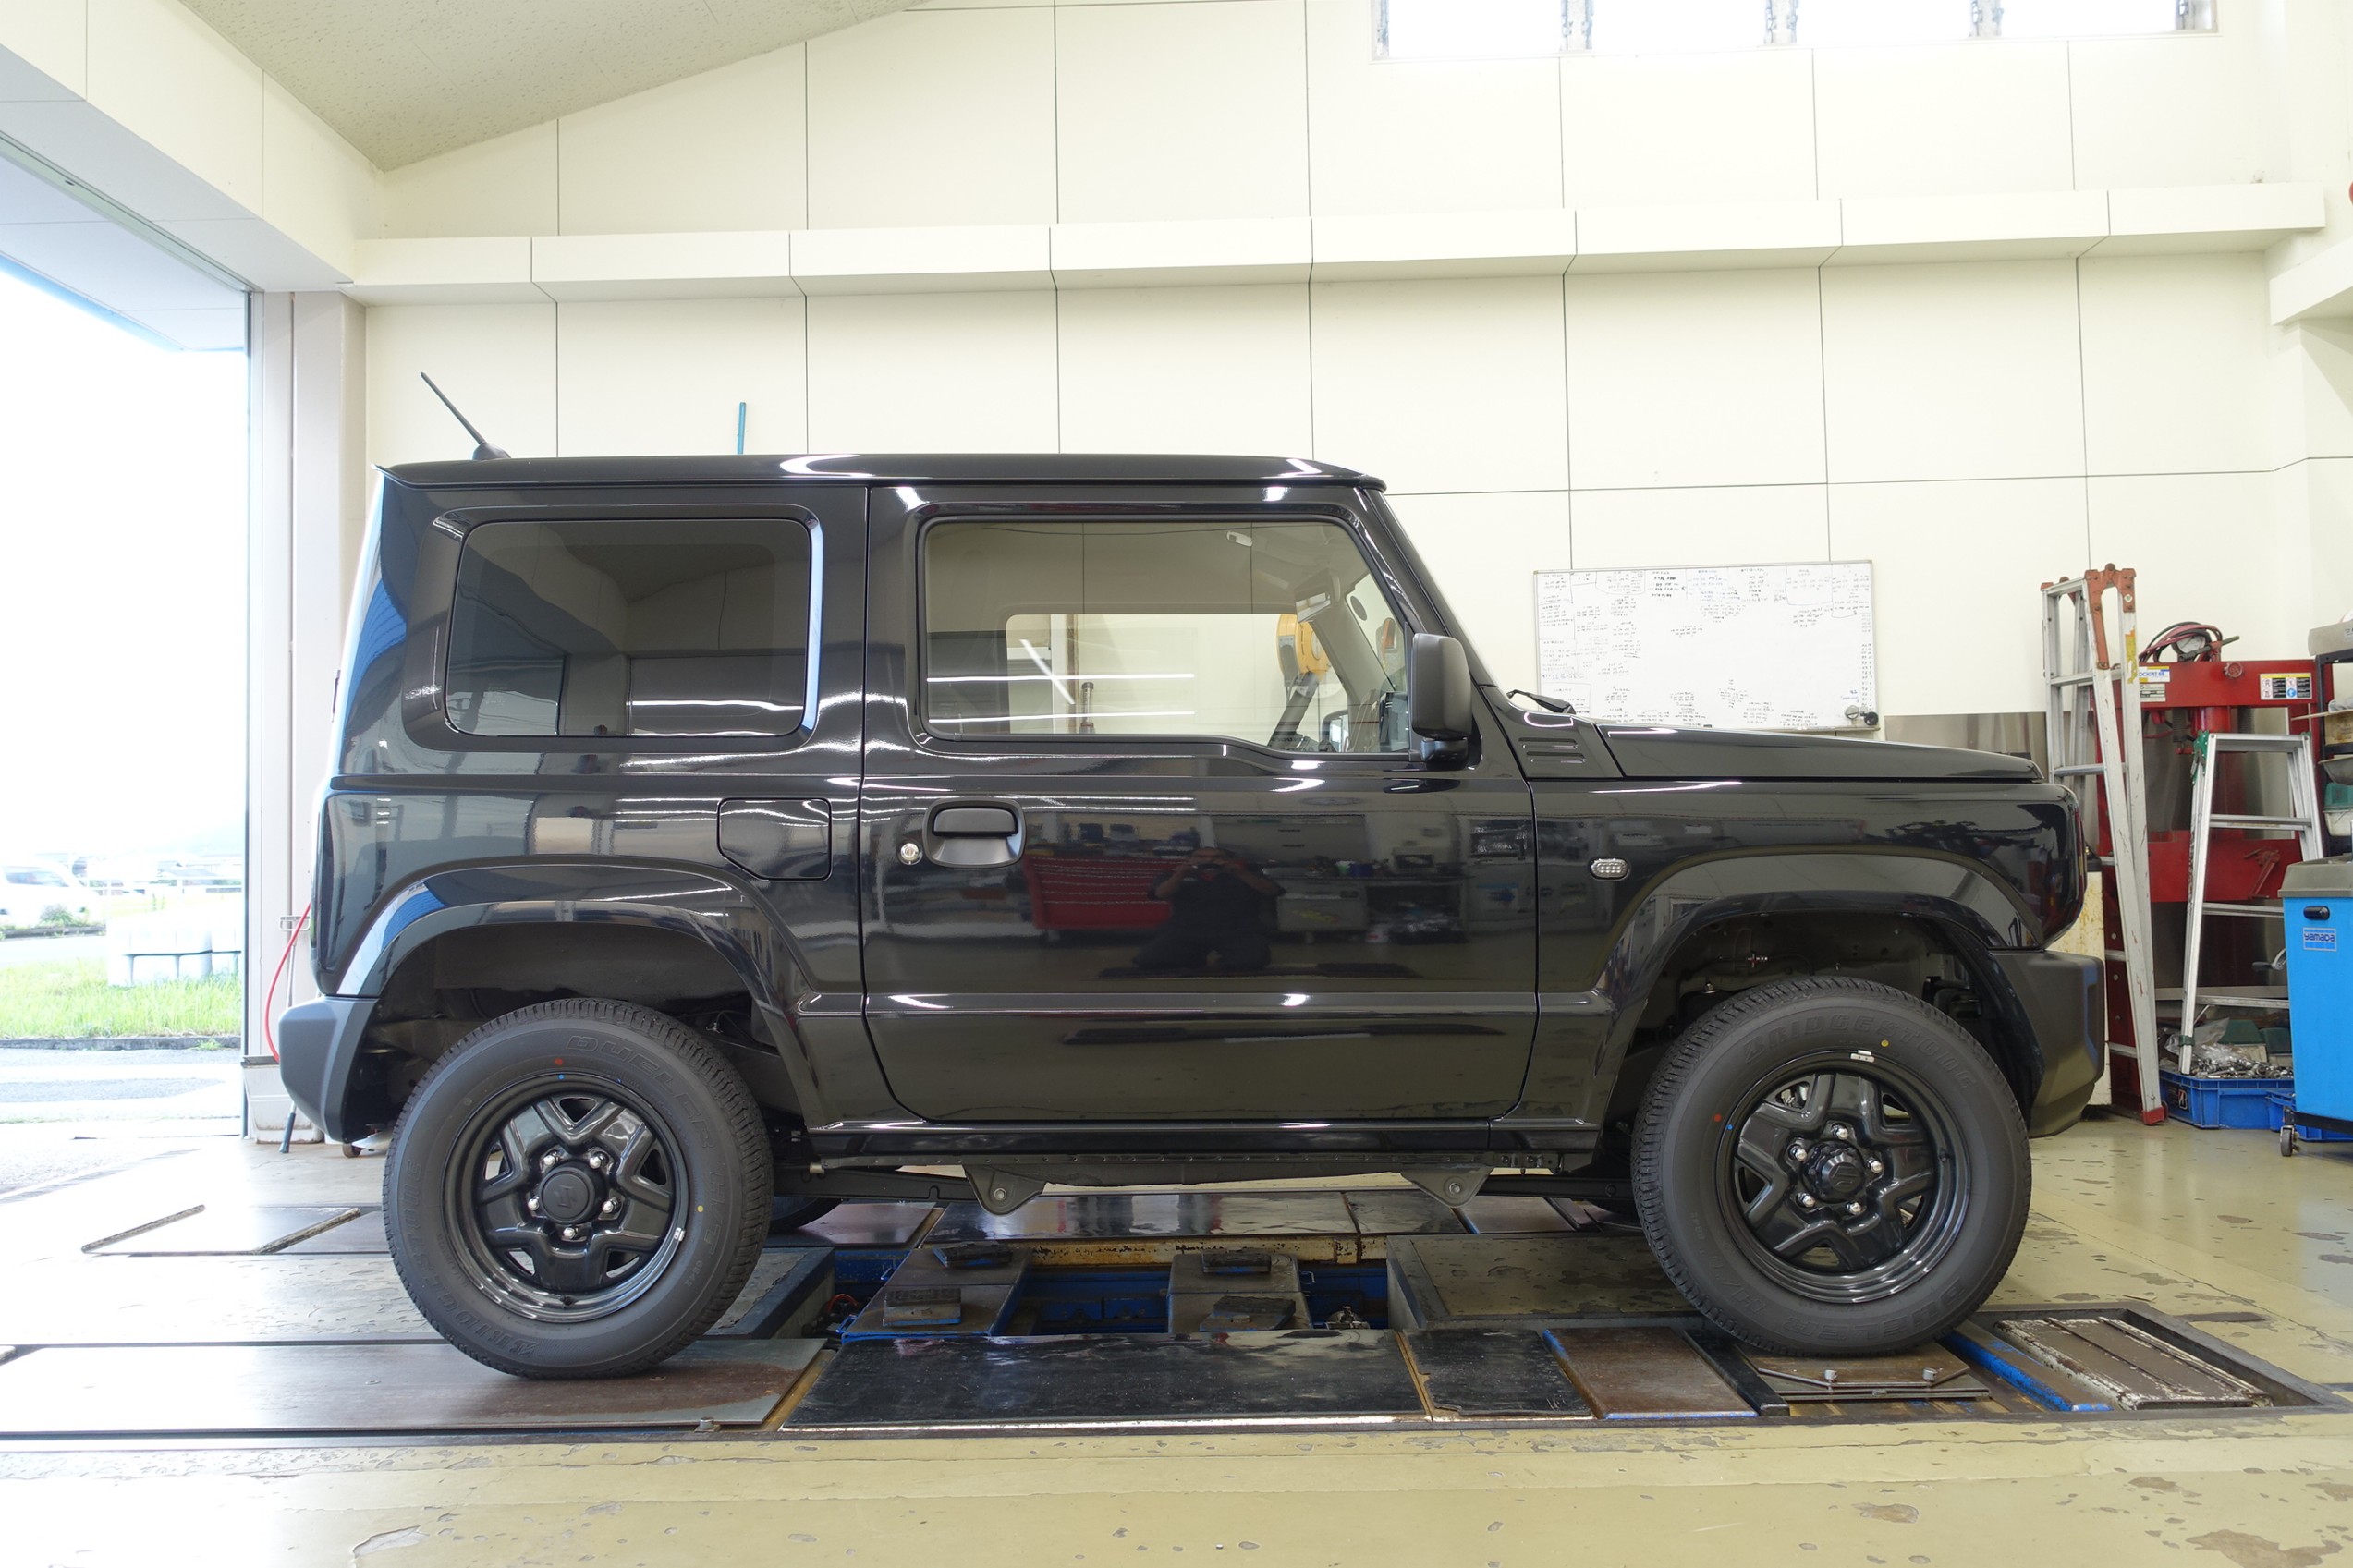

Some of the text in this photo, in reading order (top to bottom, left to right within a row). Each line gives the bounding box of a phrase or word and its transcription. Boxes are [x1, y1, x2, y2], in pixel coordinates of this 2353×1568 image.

[566, 1034, 717, 1149] DUELER
[1744, 1014, 1978, 1090] BRIDGESTONE
[398, 1159, 542, 1355] BRIDGESTONE
[1781, 1277, 1968, 1341] DUELER
